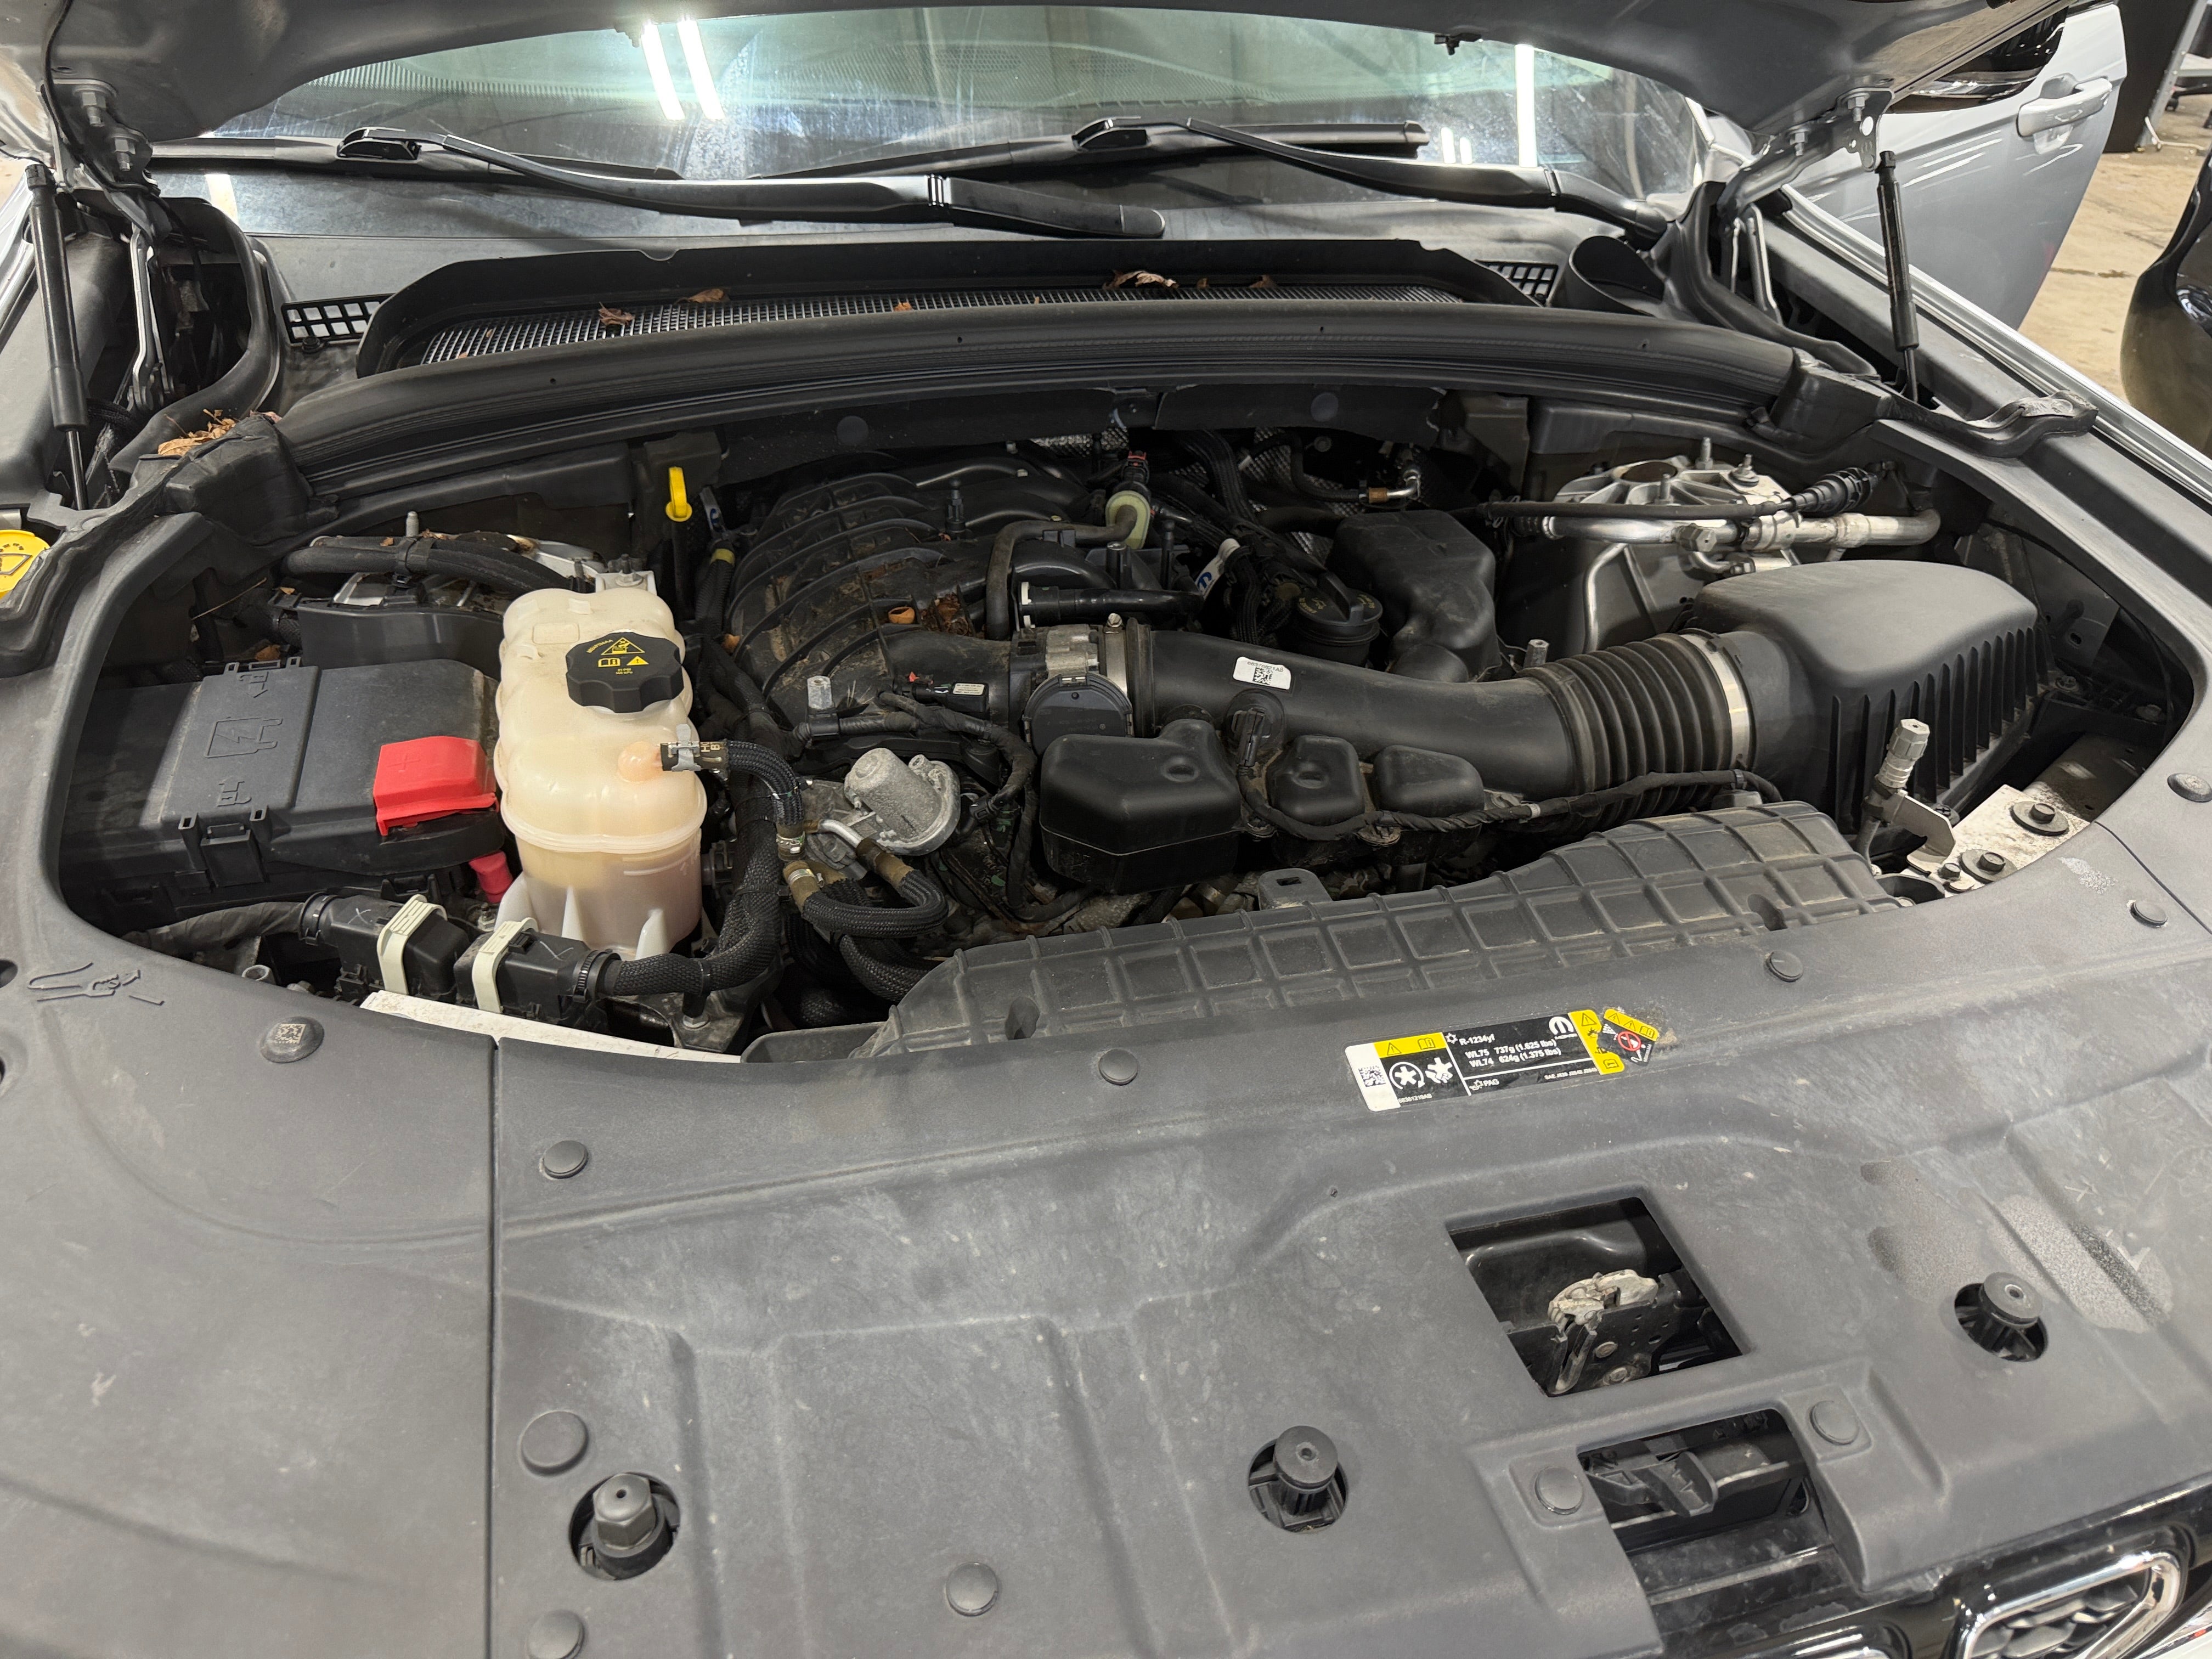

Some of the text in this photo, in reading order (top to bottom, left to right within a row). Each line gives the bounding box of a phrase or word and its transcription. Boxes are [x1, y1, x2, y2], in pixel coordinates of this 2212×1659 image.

[1459, 1034, 1496, 1046] R-1234yf
[1465, 1039, 1558, 1059] WL75 737g (1.625 lbs)
[1469, 1047, 1562, 1068] WL74 624g (1.375 lbs)
[1482, 1078, 1500, 1087] PAG
